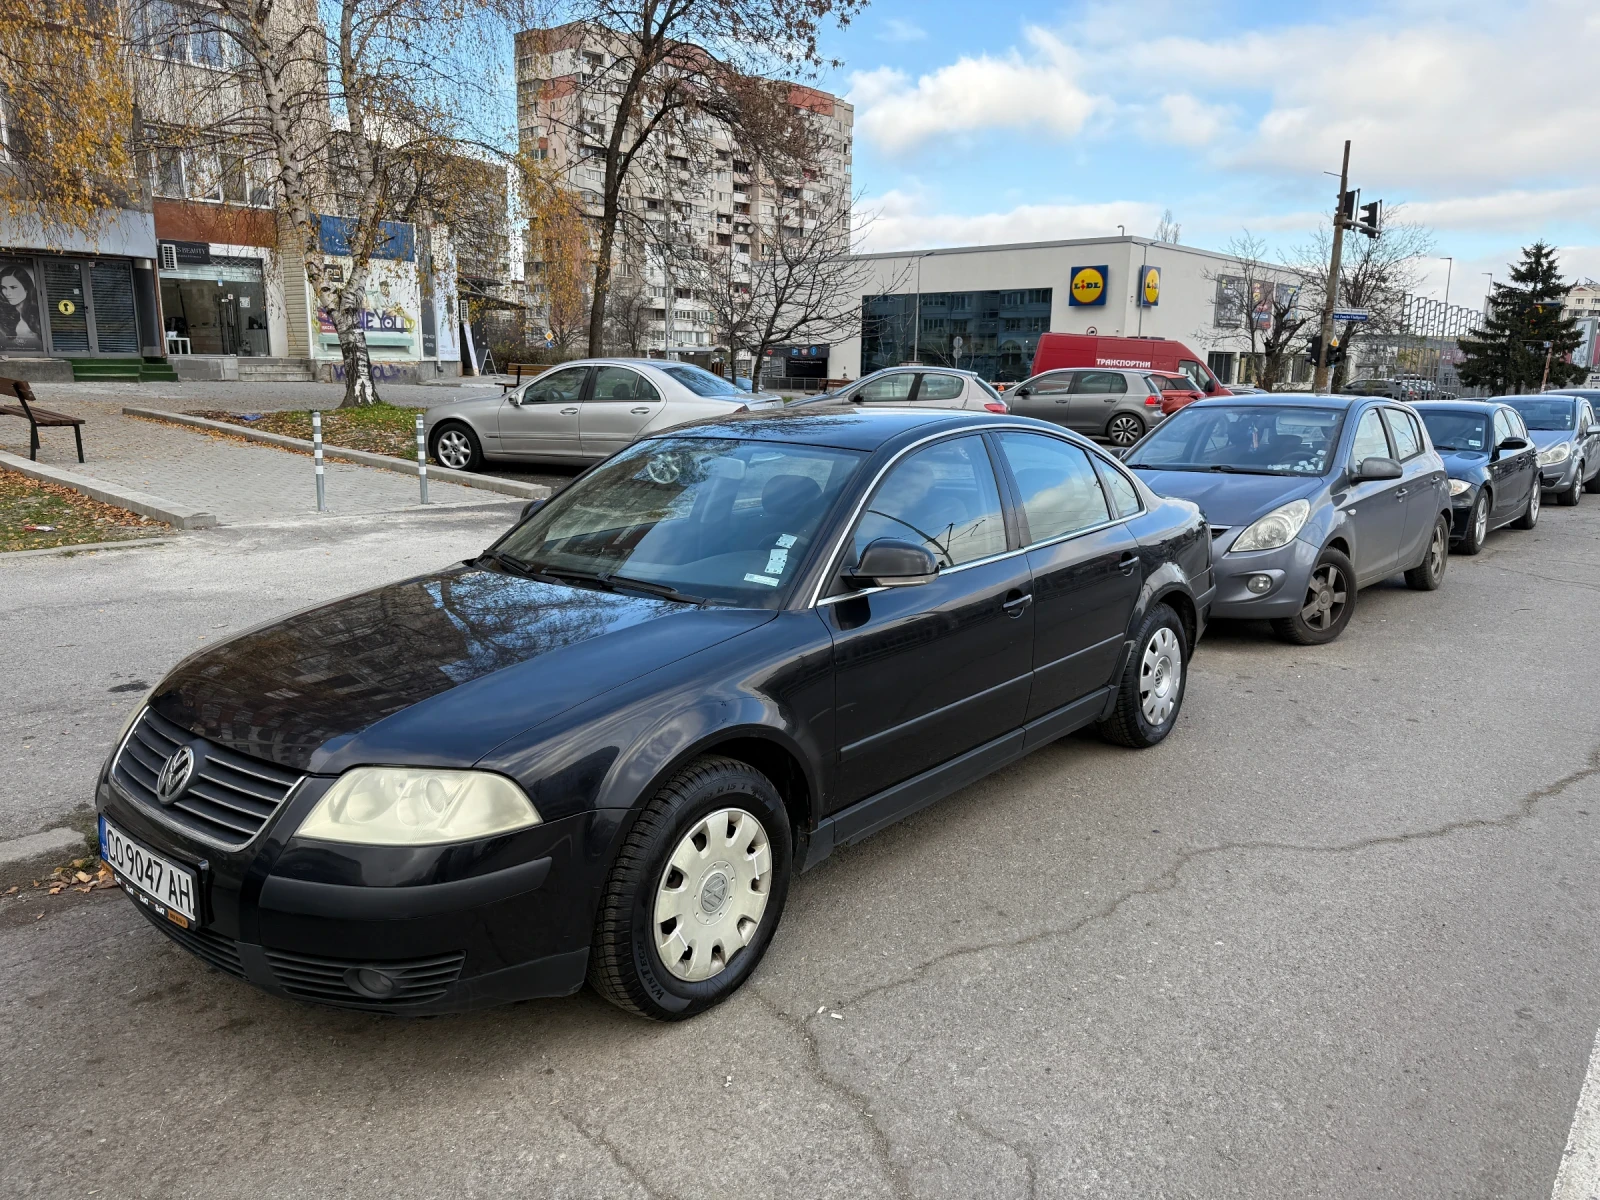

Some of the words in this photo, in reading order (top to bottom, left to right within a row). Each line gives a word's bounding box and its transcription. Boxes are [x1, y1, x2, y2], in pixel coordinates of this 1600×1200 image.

[1096, 358, 1152, 369] ТРАНСПОРТНИ
[125, 843, 163, 893] 9047
[168, 869, 192, 914] AH
